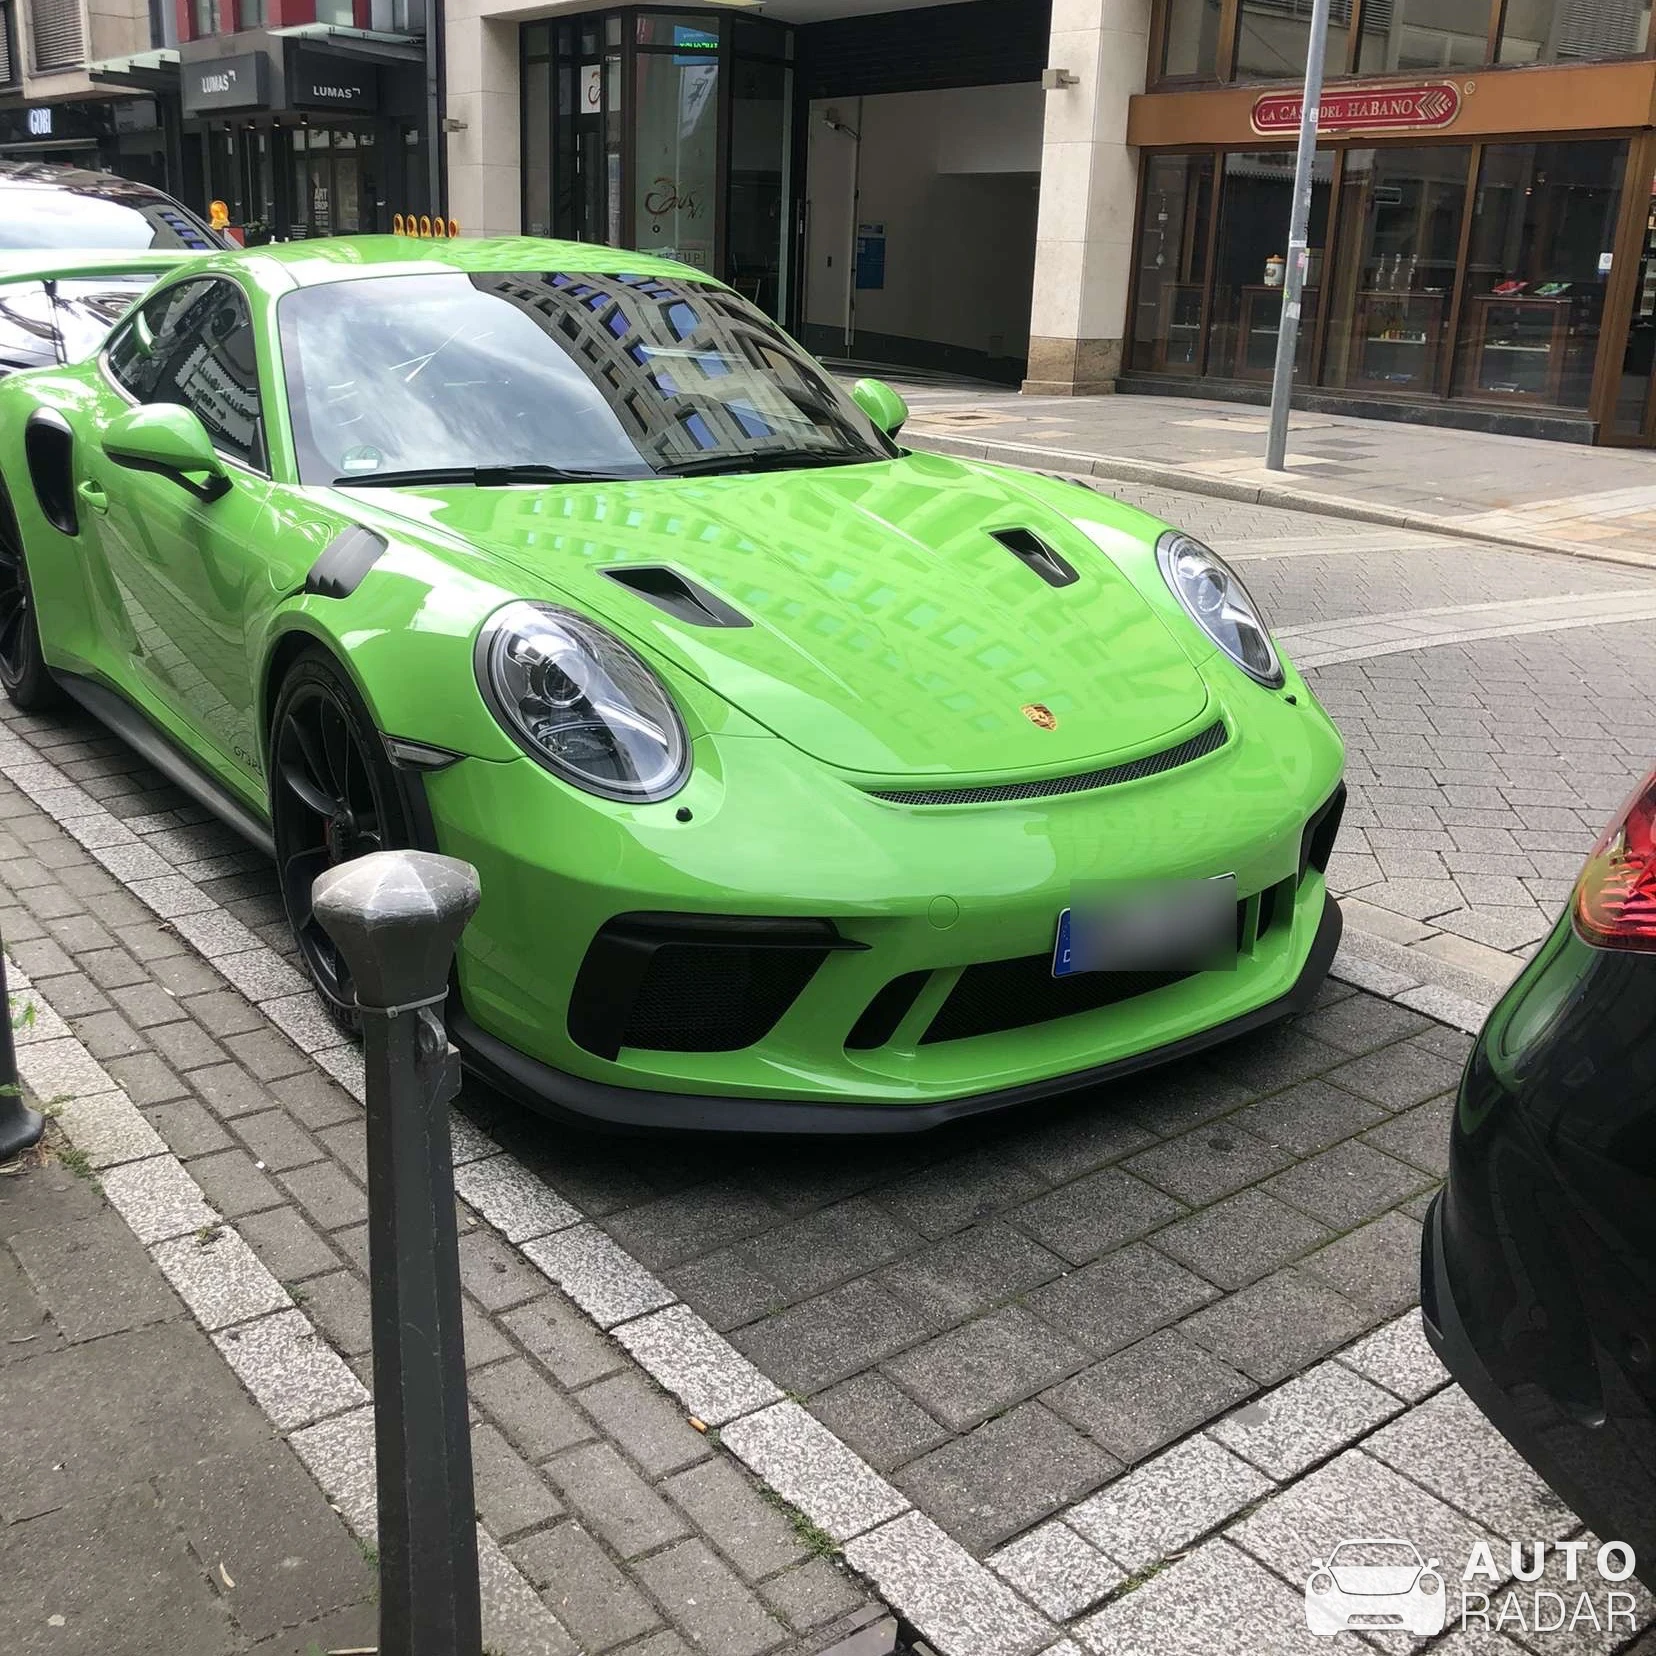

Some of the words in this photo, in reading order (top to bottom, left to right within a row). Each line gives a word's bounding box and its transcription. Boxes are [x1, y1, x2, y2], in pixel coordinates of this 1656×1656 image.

[202, 74, 230, 93] LUMAS
[313, 85, 352, 99] LUMAS
[1260, 108, 1276, 122] LA
[1279, 105, 1303, 120] CAS
[1319, 105, 1343, 118] DEL
[1347, 99, 1414, 117] HABANO
[30, 108, 52, 135] GOBI
